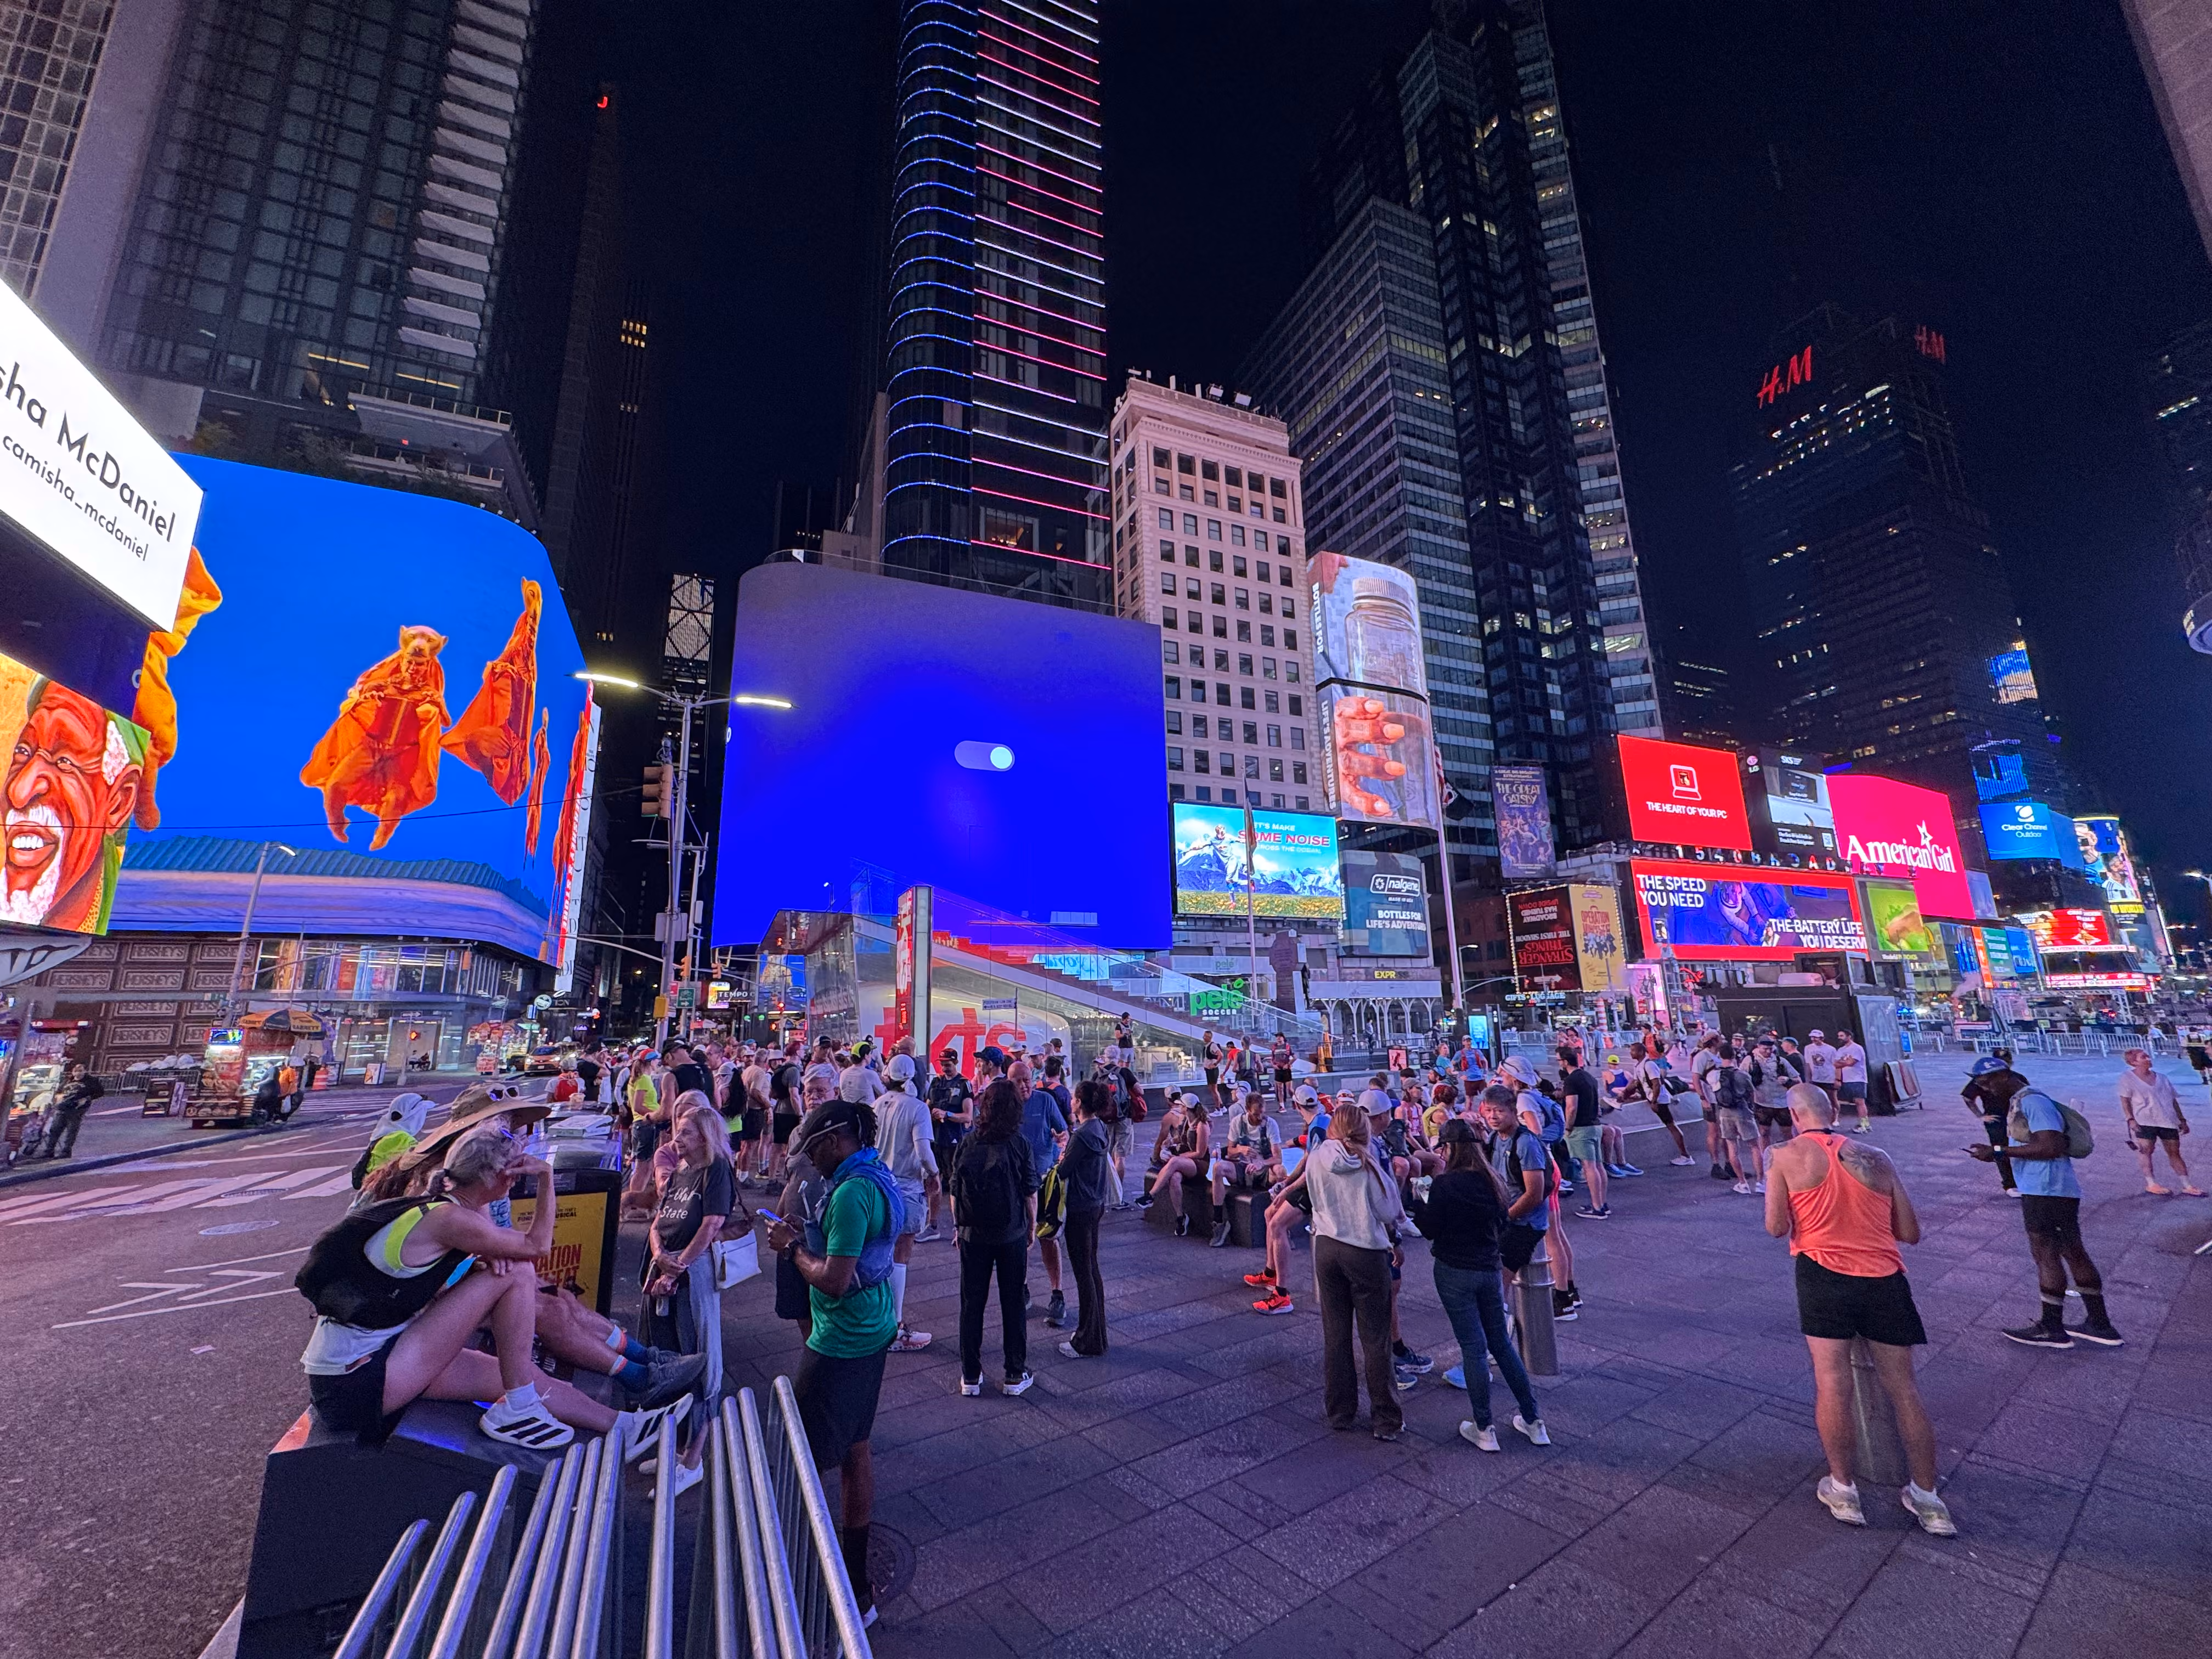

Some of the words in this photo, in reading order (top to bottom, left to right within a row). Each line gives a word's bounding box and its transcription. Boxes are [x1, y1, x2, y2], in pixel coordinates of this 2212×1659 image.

[1757, 345, 1812, 409] H&M
[57, 410, 176, 543] McDaniel
[3, 435, 149, 562] camisha_mcdaniel
[1312, 582, 1322, 629] BOTTLES
[1320, 700, 1330, 733] LIFE'S
[1323, 733, 1338, 810] ADVENTURES
[1496, 782, 1511, 794] THE
[1513, 784, 1541, 794] GREAT
[1503, 794, 1537, 804] GATSBY
[1646, 801, 1662, 811] THE
[1662, 803, 1686, 814] HEART
[1686, 806, 1696, 815] OF
[1697, 808, 1717, 818] YOUR
[1717, 810, 1728, 819] PC
[1285, 834, 1330, 847] NOISE
[1846, 834, 1933, 870] American
[1931, 844, 1957, 873] Girl
[1388, 878, 1419, 893] nalgene
[1636, 874, 1664, 890] THE
[1665, 876, 1706, 893] SPEED
[1518, 902, 1537, 910] DOWN
[1638, 890, 1667, 906] YOU
[1669, 892, 1704, 908] NEED
[1378, 910, 1410, 919] BOTTLES
[1411, 911, 1422, 921] FOR
[1523, 912, 1558, 923] BROADWAY
[1581, 911, 1610, 923] OPERATION
[1365, 919, 1390, 929] LIFE'S
[1768, 918, 1793, 933] THE
[1794, 919, 1839, 934] BATTERY
[1842, 921, 1864, 935] LIFE
[1515, 933, 1539, 943] SHADOW
[1541, 931, 1558, 939] FIRST
[1525, 939, 1563, 952] THINGS
[1517, 947, 1575, 964] STRANGER
[1189, 978, 1244, 1016] pelé
[660, 1206, 689, 1220] State
